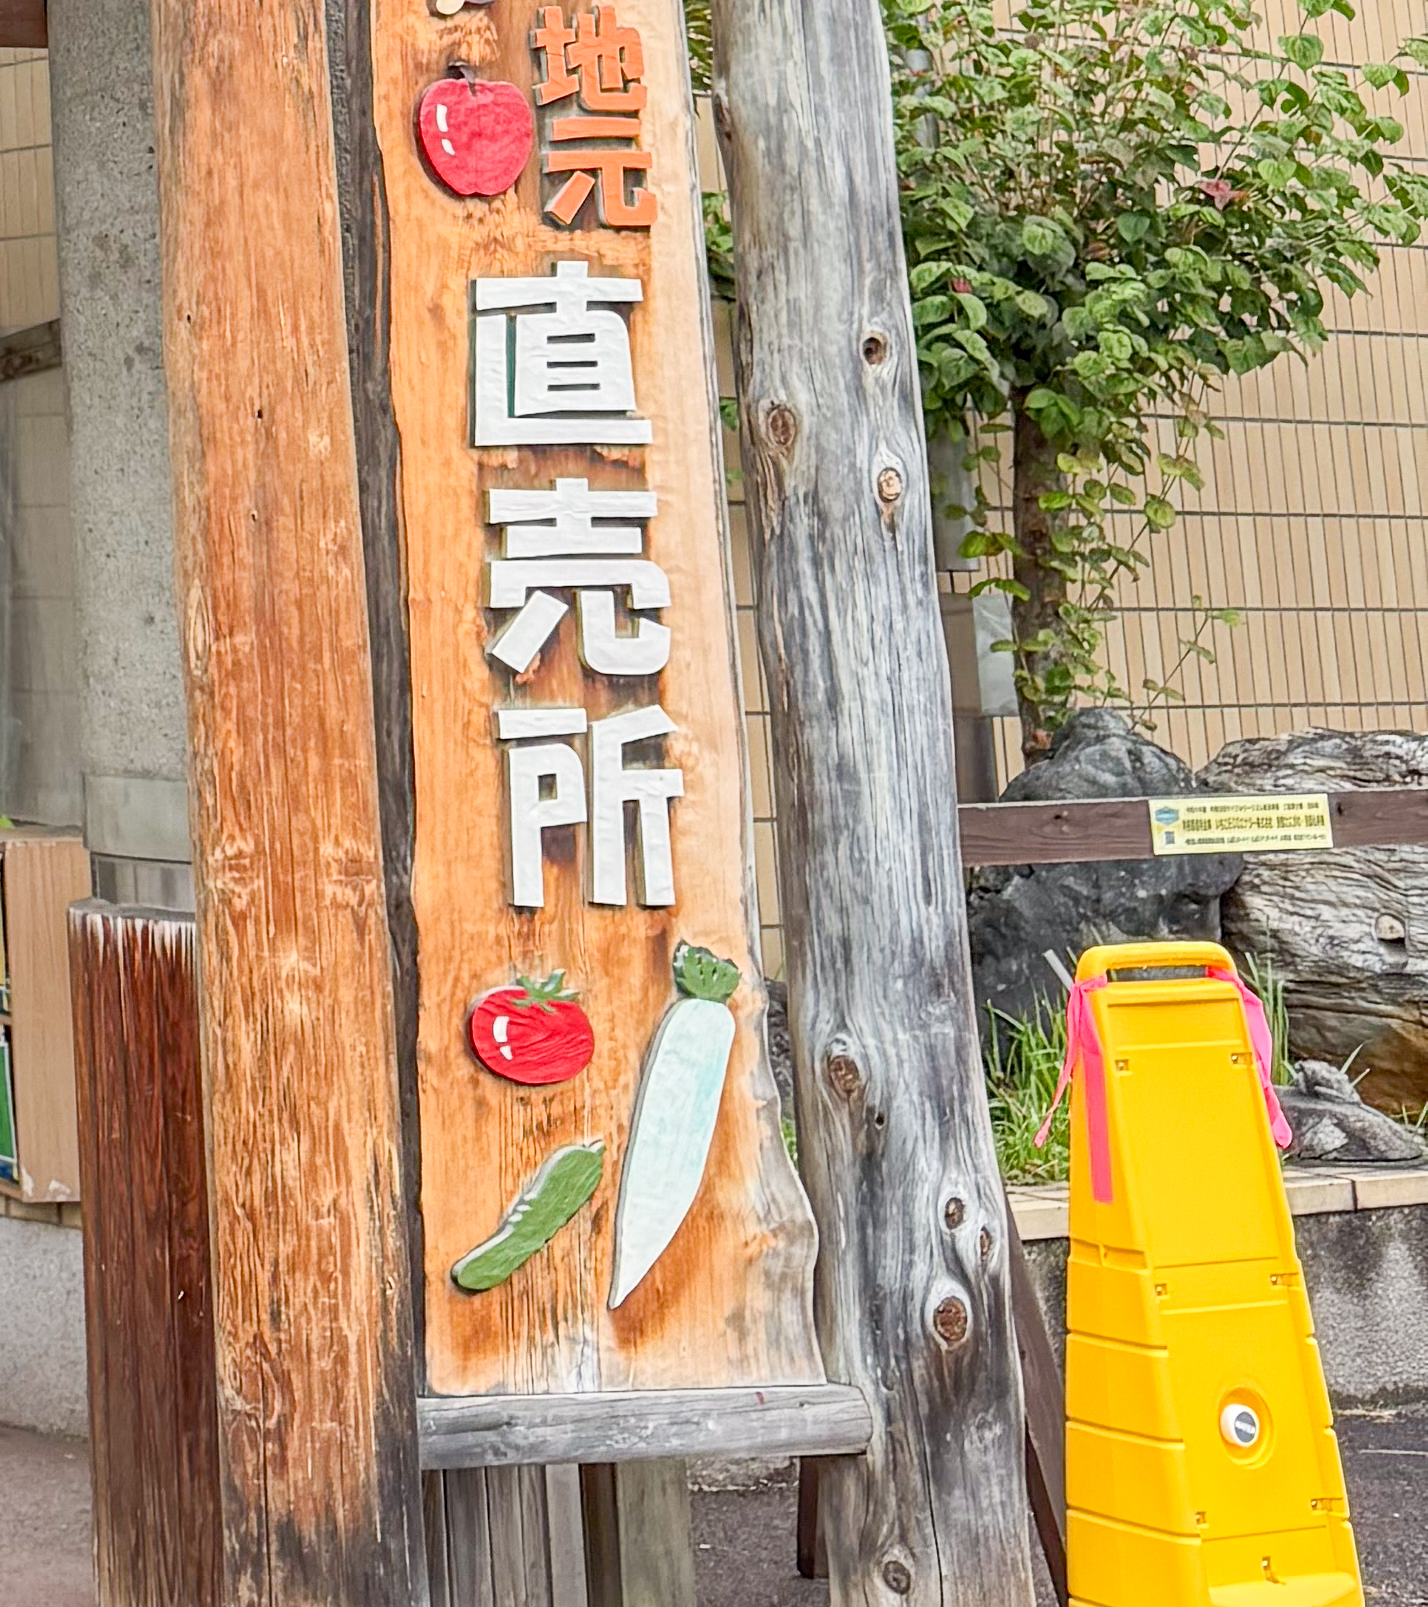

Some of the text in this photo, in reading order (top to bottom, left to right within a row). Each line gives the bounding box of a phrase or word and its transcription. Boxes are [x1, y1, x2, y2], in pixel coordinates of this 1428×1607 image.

[471, 5, 684, 908] 地元直売所
